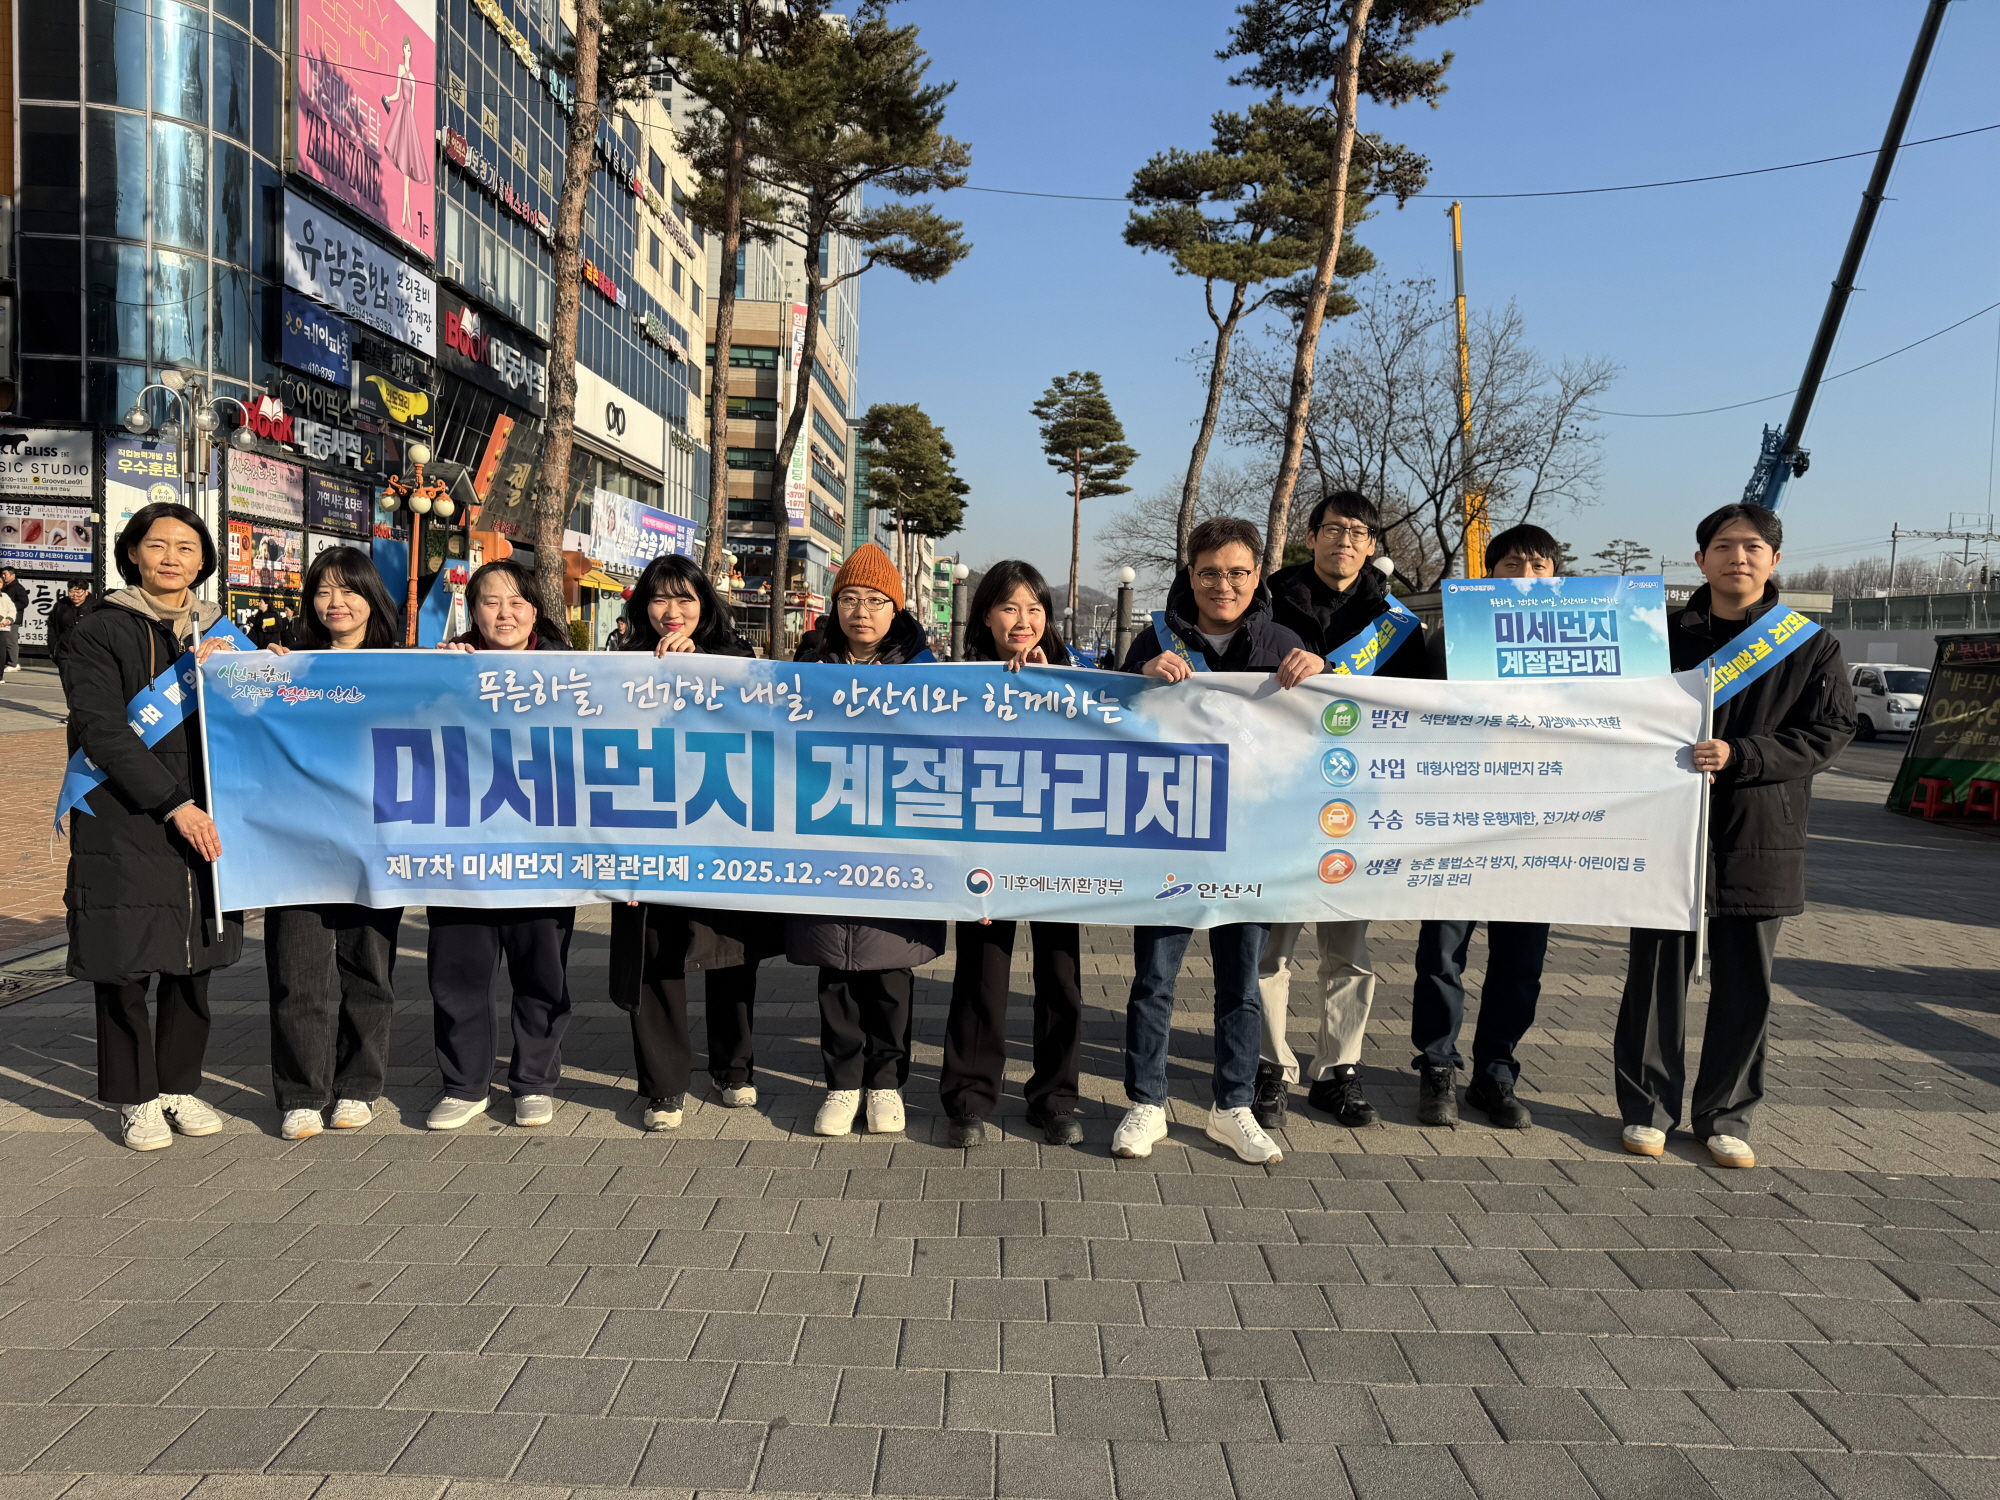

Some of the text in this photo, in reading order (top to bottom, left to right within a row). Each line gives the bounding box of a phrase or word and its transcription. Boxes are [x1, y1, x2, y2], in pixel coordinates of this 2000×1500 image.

[347, 139, 380, 206] ZONE
[417, 211, 429, 240] 1F
[296, 218, 390, 310] 유담들밥
[396, 270, 431, 305] 보리굴비
[395, 296, 433, 333] 간장게장
[410, 330, 423, 348] 2F
[308, 361, 336, 382] 410-8797
[490, 336, 545, 404] 대동서적
[24, 446, 58, 457] BLISS
[117, 449, 164, 461] 직업능력개발
[293, 416, 366, 472] 대동서적
[363, 443, 376, 465] 2F
[31, 462, 89, 476] STUDIO
[41, 478, 83, 486] GrooveLee91
[236, 483, 256, 495] NAVER
[7, 505, 31, 516] 전문샵
[37, 506, 63, 516] BEAUTY
[330, 493, 345, 510] 사주
[344, 497, 351, 510] &
[350, 498, 364, 513] 타로
[1517, 597, 1539, 607] 건강한
[1559, 596, 1589, 606] 안산시와
[1589, 595, 1620, 606] 함께하는
[1494, 609, 1619, 644] 미세먼지
[1350, 619, 1398, 671] 미세먼지
[1500, 649, 1618, 676] 계절관리제
[216, 661, 261, 687] 시민과
[231, 684, 366, 706] 자유로운 혁신도시 안산
[478, 667, 1124, 725] 푸른하늘, 건강한 내일, 안산시와 함께하는
[1370, 709, 1622, 731] 발전 석탄발전 가동 축소, 재생에너지 전환
[1367, 757, 1563, 780] 산업 대형사업장 미세먼지 감축
[371, 725, 1214, 840] 미세먼지 계절관리제
[1367, 809, 1606, 831] 수송 5등급 차량 운행제한, 전기차 이용
[385, 852, 934, 891] 제7차 미세먼지 계절관리제 : 2025.12.~2026.3.
[1364, 857, 1402, 876] 생활
[1409, 856, 1436, 872] 농촌
[1437, 856, 1488, 871] 불법소각
[1489, 856, 1519, 872] 방지,
[1632, 856, 1647, 872] 등
[999, 872, 1125, 896] 기후에너지환경부
[1196, 880, 1264, 900] 안산시
[1406, 873, 1473, 888] 공기질 관리
